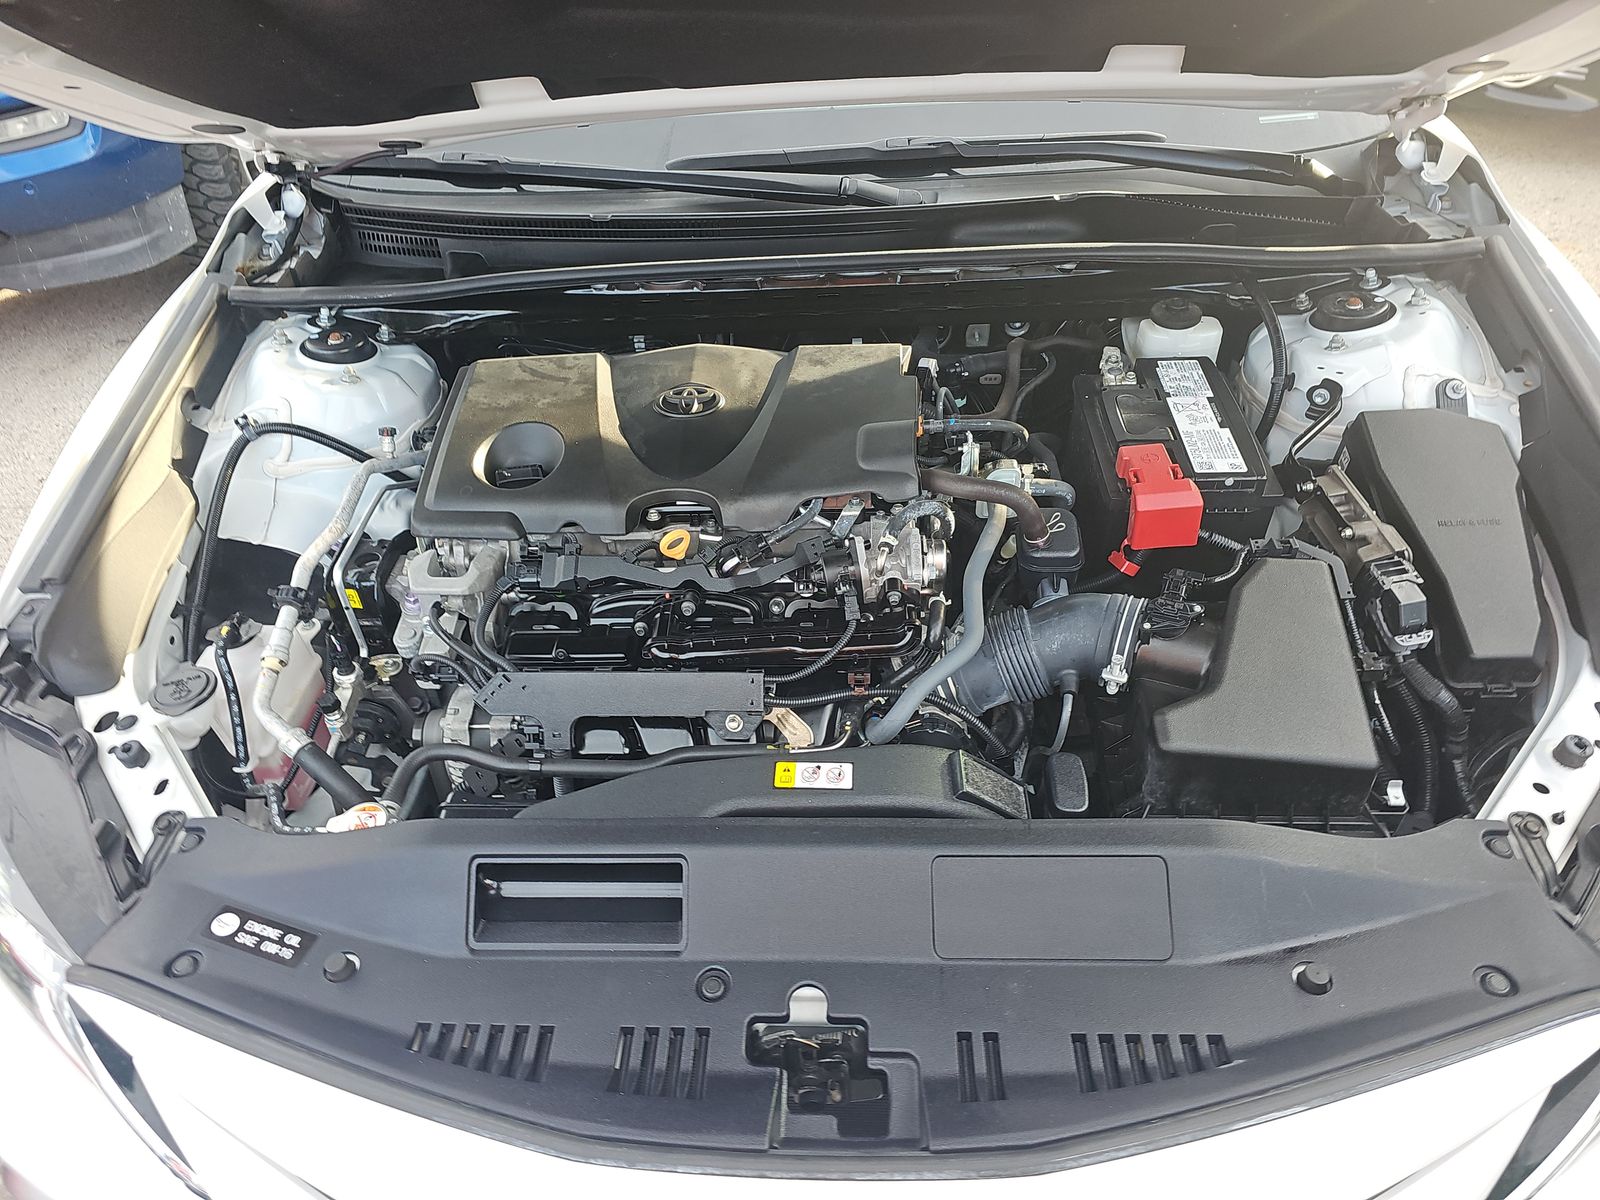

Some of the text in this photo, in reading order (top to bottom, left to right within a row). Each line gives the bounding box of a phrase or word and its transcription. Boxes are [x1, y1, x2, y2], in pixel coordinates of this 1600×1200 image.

[1437, 519, 1466, 528] RELAY
[234, 931, 260, 948] SAE
[243, 920, 302, 948] ENGINE OIL
